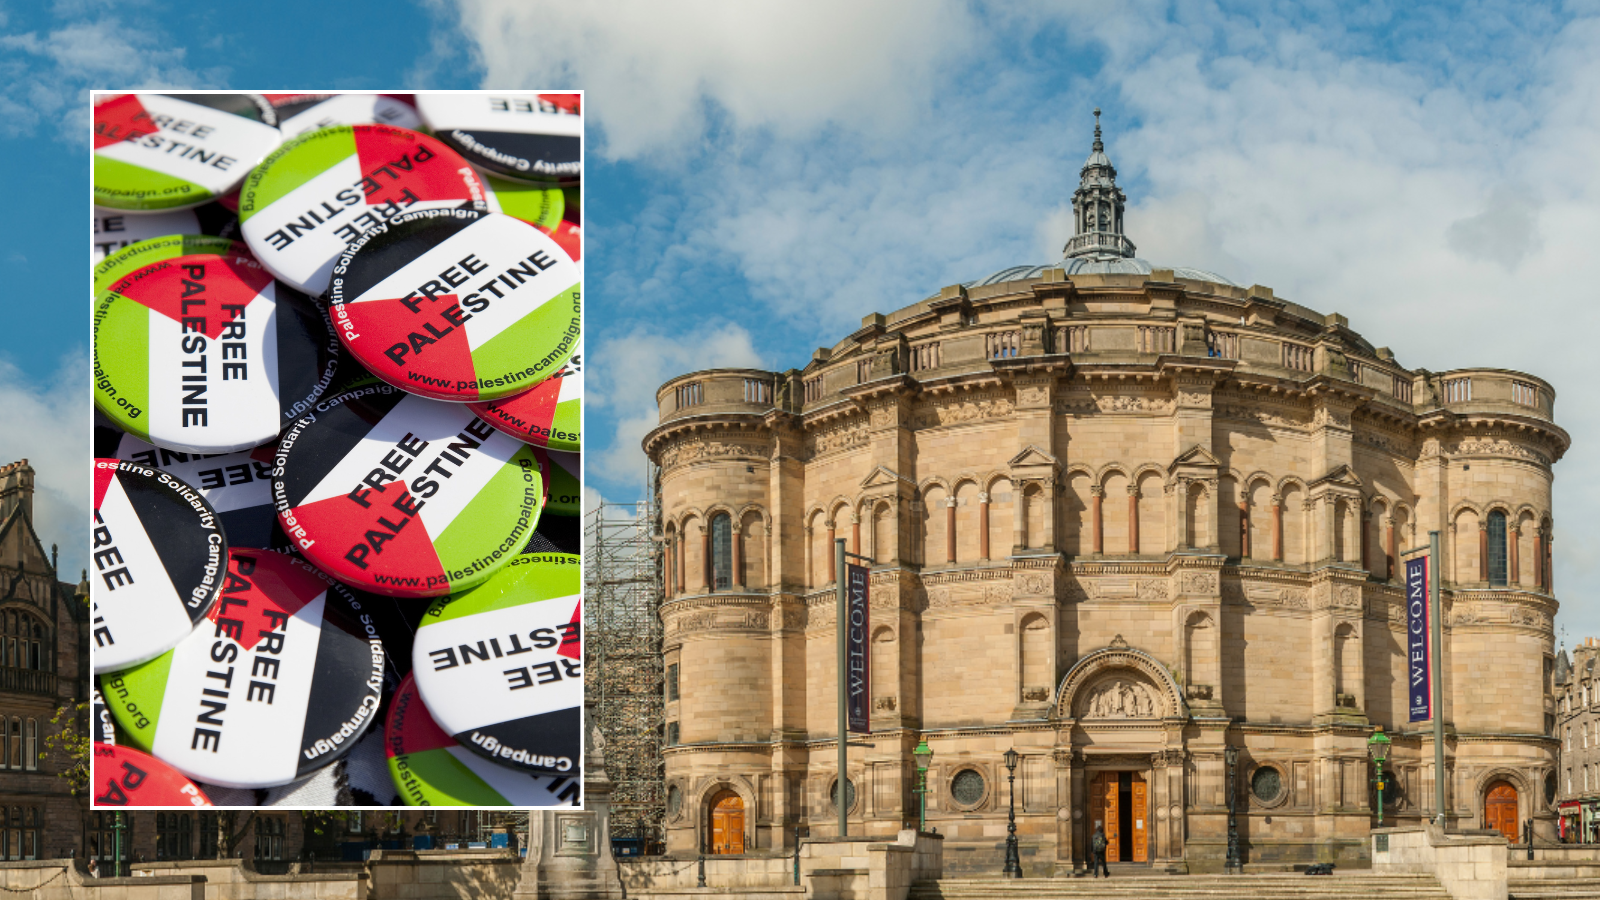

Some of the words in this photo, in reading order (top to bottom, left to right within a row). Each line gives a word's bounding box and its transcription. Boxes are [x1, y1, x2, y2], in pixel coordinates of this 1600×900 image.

[133, 111, 215, 139] FREE
[451, 129, 530, 171] Campaign
[264, 145, 436, 252] PALESTINE
[333, 187, 422, 246] FREE
[390, 208, 479, 226] Campaign
[334, 221, 389, 275] Solidarity
[330, 278, 361, 342] Palestine
[383, 249, 558, 367] PALESTINE
[399, 253, 490, 314] FREE
[181, 264, 209, 428] PALESTINE
[221, 304, 248, 381] FREE
[285, 360, 338, 419] Campaign
[487, 402, 581, 442] www.pales
[272, 412, 317, 476] Solidarity
[347, 432, 430, 509] FREE
[274, 481, 315, 550] Palestine
[343, 416, 497, 571] PALESTINE
[374, 458, 537, 589] www.palestinecampaign.org
[157, 472, 216, 530] Solidarity
[187, 533, 222, 609] Campaign
[290, 557, 362, 611] Palestine
[190, 554, 257, 754] PALESTINE
[246, 609, 290, 705] FREE
[360, 614, 385, 693] Solidarity
[851, 572, 866, 698] WELCOME
[1410, 564, 1424, 688] WELCOME
[304, 695, 379, 760] Campaign
[471, 731, 572, 771] Campaign
